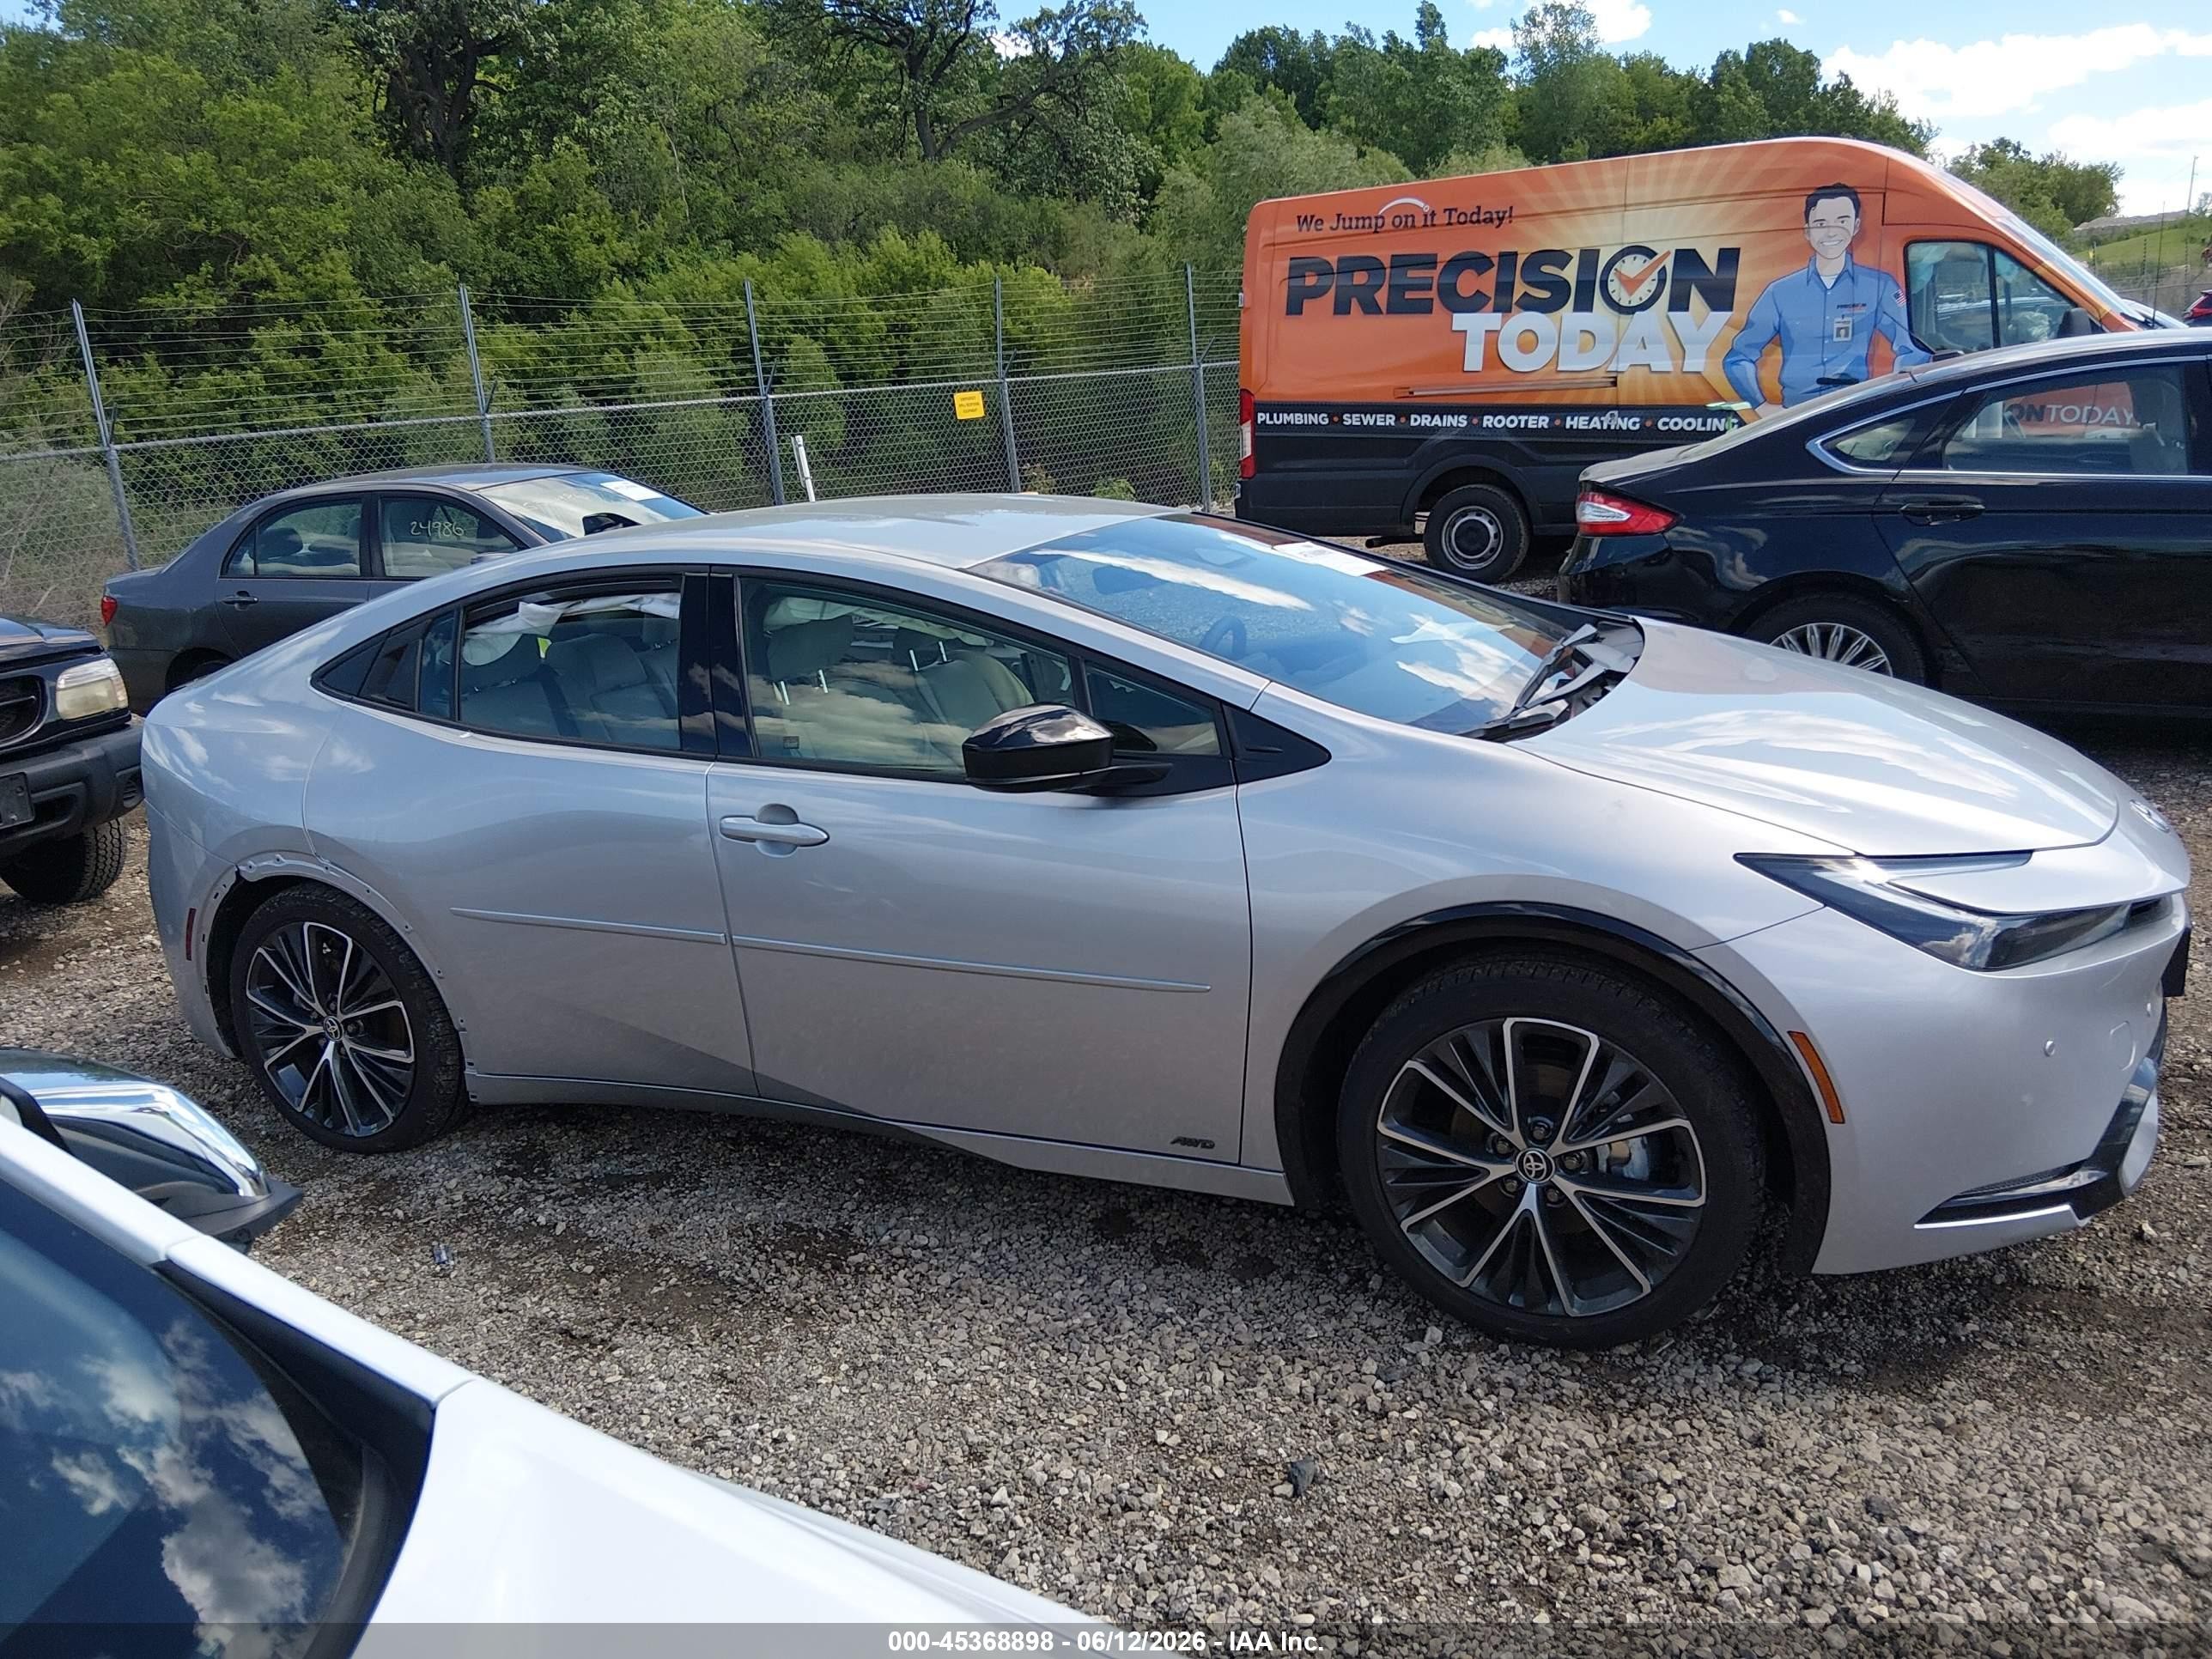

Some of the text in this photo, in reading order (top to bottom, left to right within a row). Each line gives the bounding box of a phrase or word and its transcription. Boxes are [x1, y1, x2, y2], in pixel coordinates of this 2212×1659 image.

[1297, 206, 1514, 234] We Jump on it Today!
[1285, 246, 1741, 315] PRECISION
[1451, 311, 1731, 372] TODAY
[1257, 412, 1739, 432] PLUMBING SEWER DRAINS ROOTER HEATING COOLING
[410, 520, 465, 539] 24986
